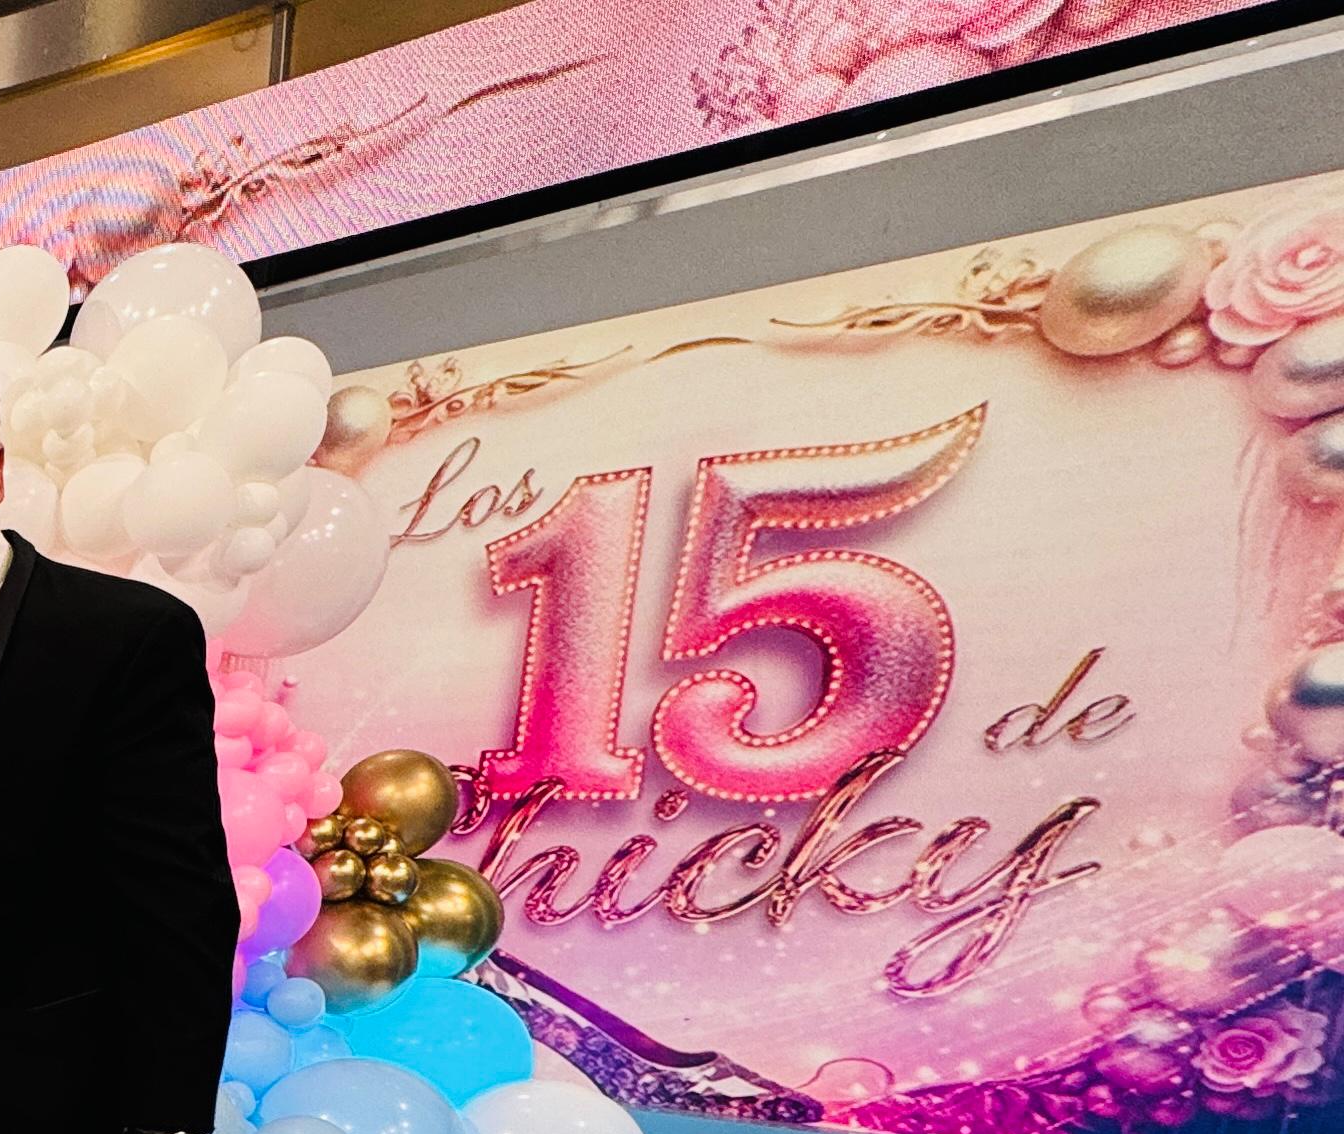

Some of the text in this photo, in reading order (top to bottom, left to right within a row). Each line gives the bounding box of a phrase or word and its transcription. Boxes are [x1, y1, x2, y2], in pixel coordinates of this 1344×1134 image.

[389, 400, 1137, 802] Los 15 de
[448, 747, 1103, 997] hicky
